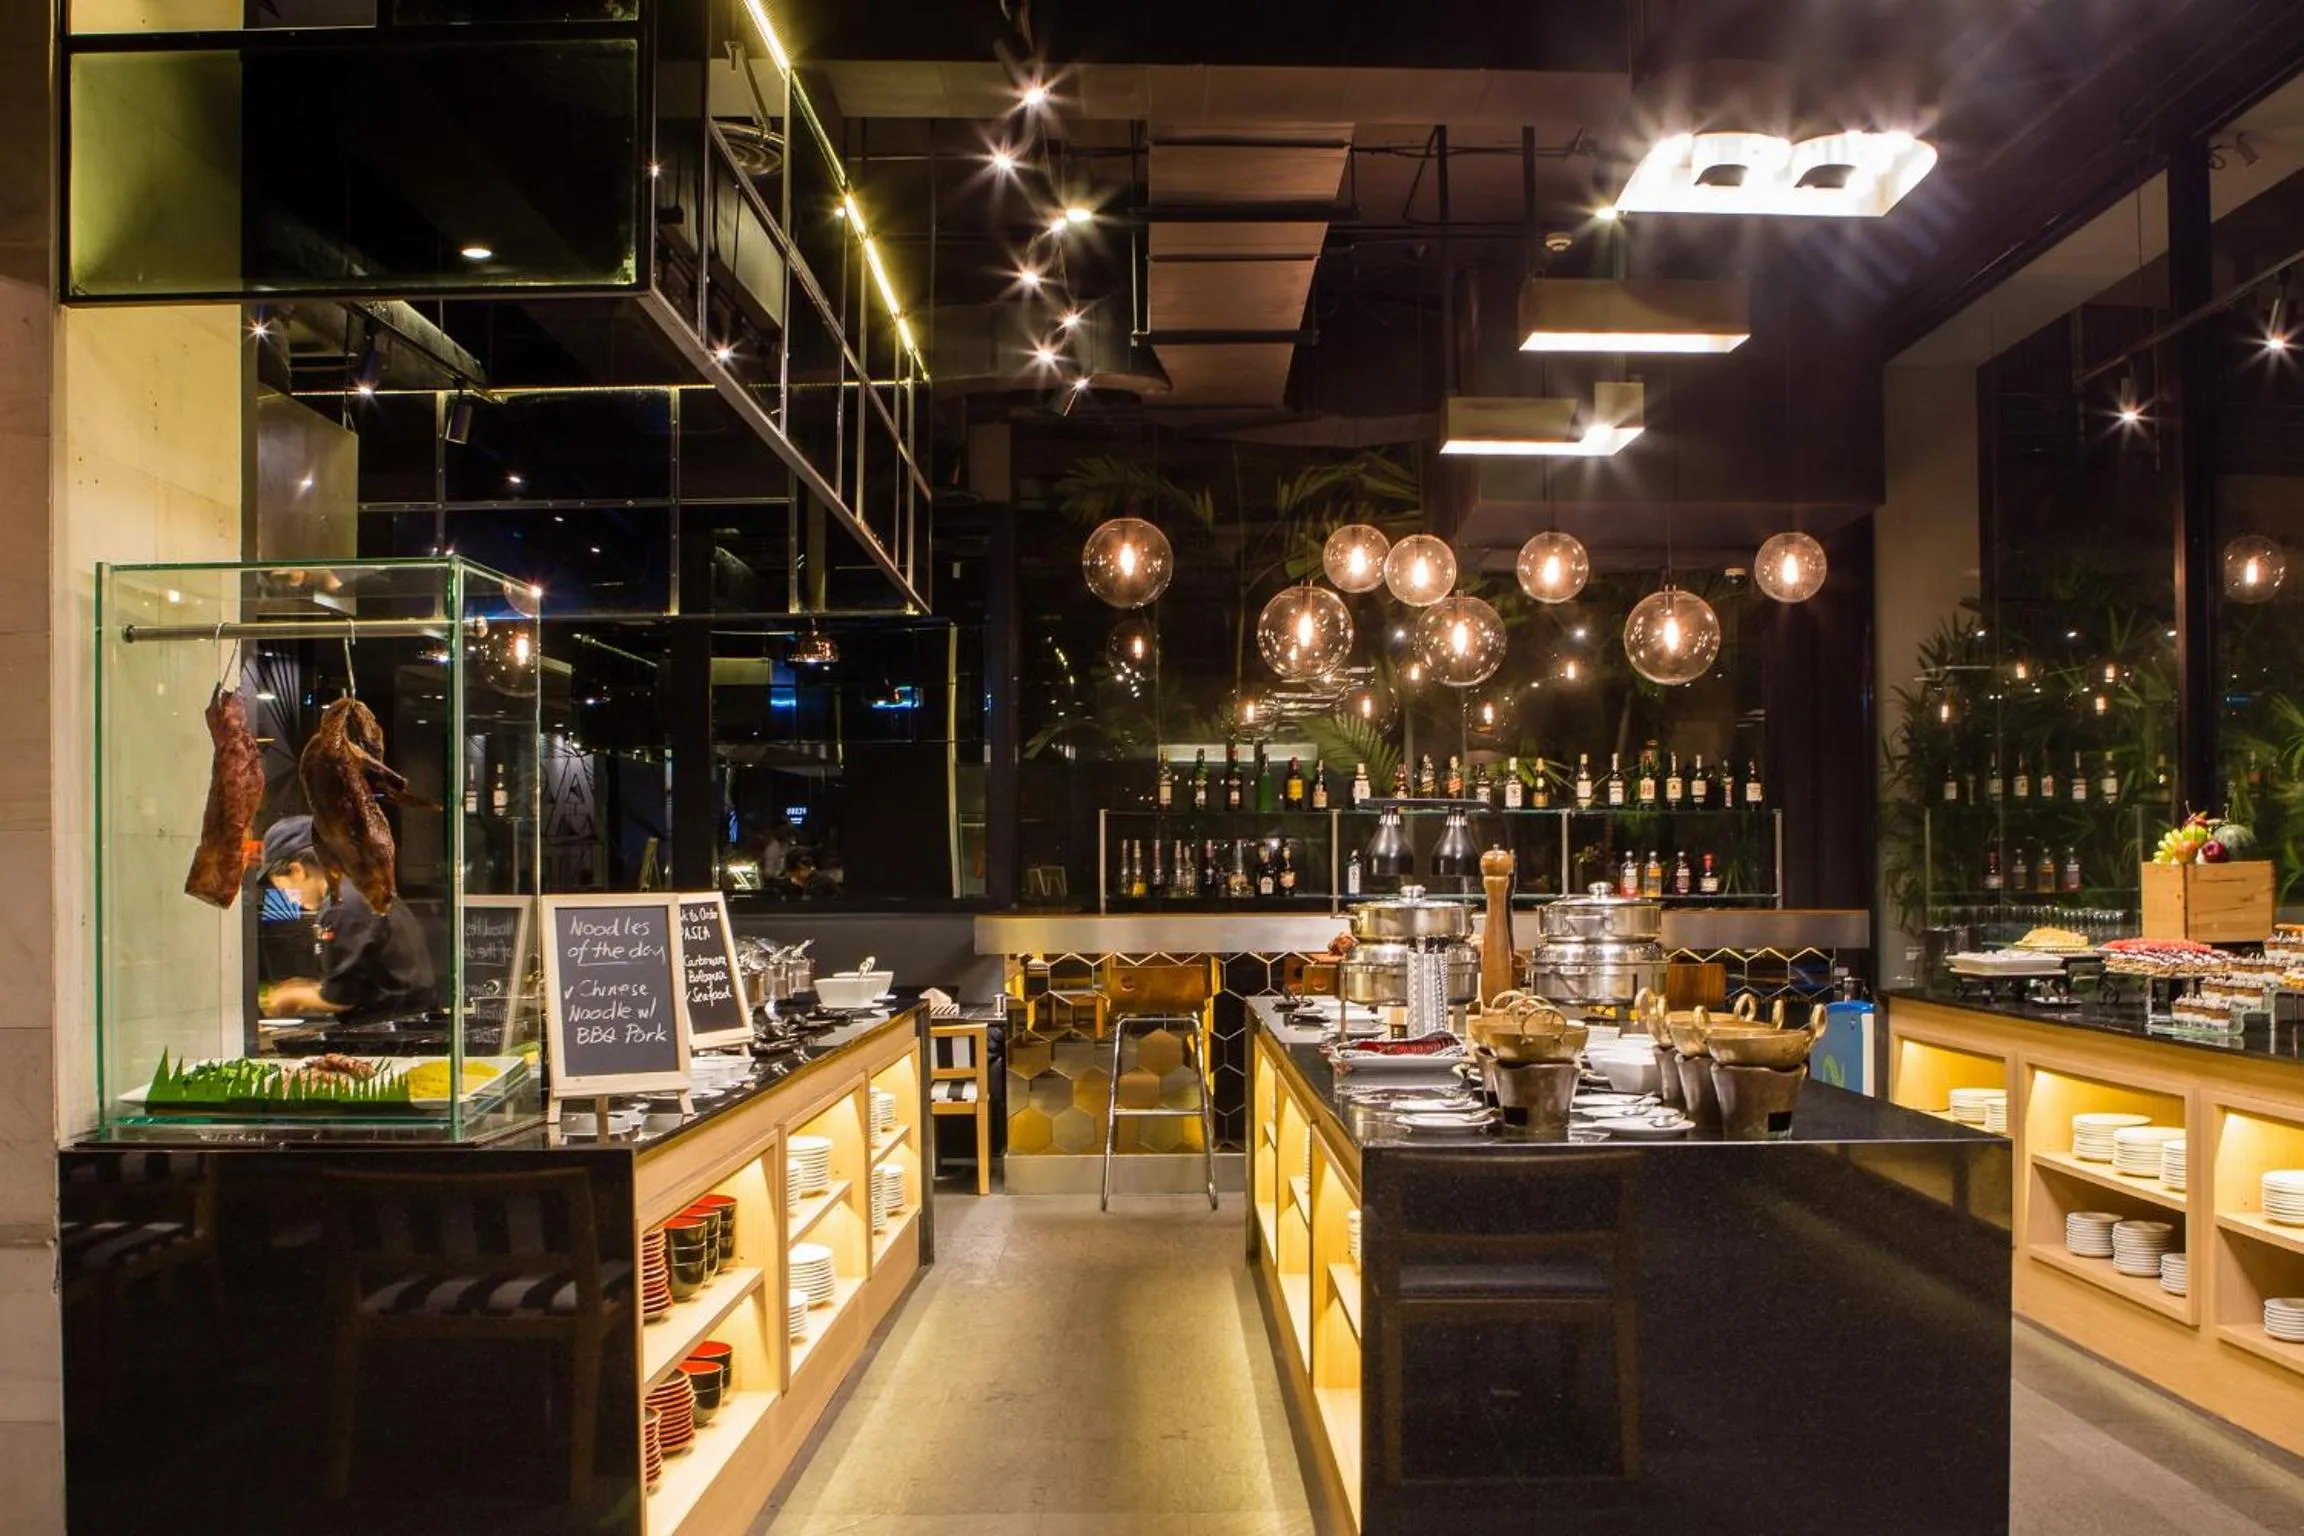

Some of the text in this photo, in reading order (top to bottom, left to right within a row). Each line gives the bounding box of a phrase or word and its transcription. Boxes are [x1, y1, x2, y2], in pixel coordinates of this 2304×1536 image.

[569, 915, 650, 936] Noodles
[567, 939, 666, 965] of the day
[579, 979, 649, 997] Chinese
[691, 985, 732, 1008] Seafood
[568, 1000, 632, 1022] Noodle
[576, 1022, 668, 1044] BBQ Pork
